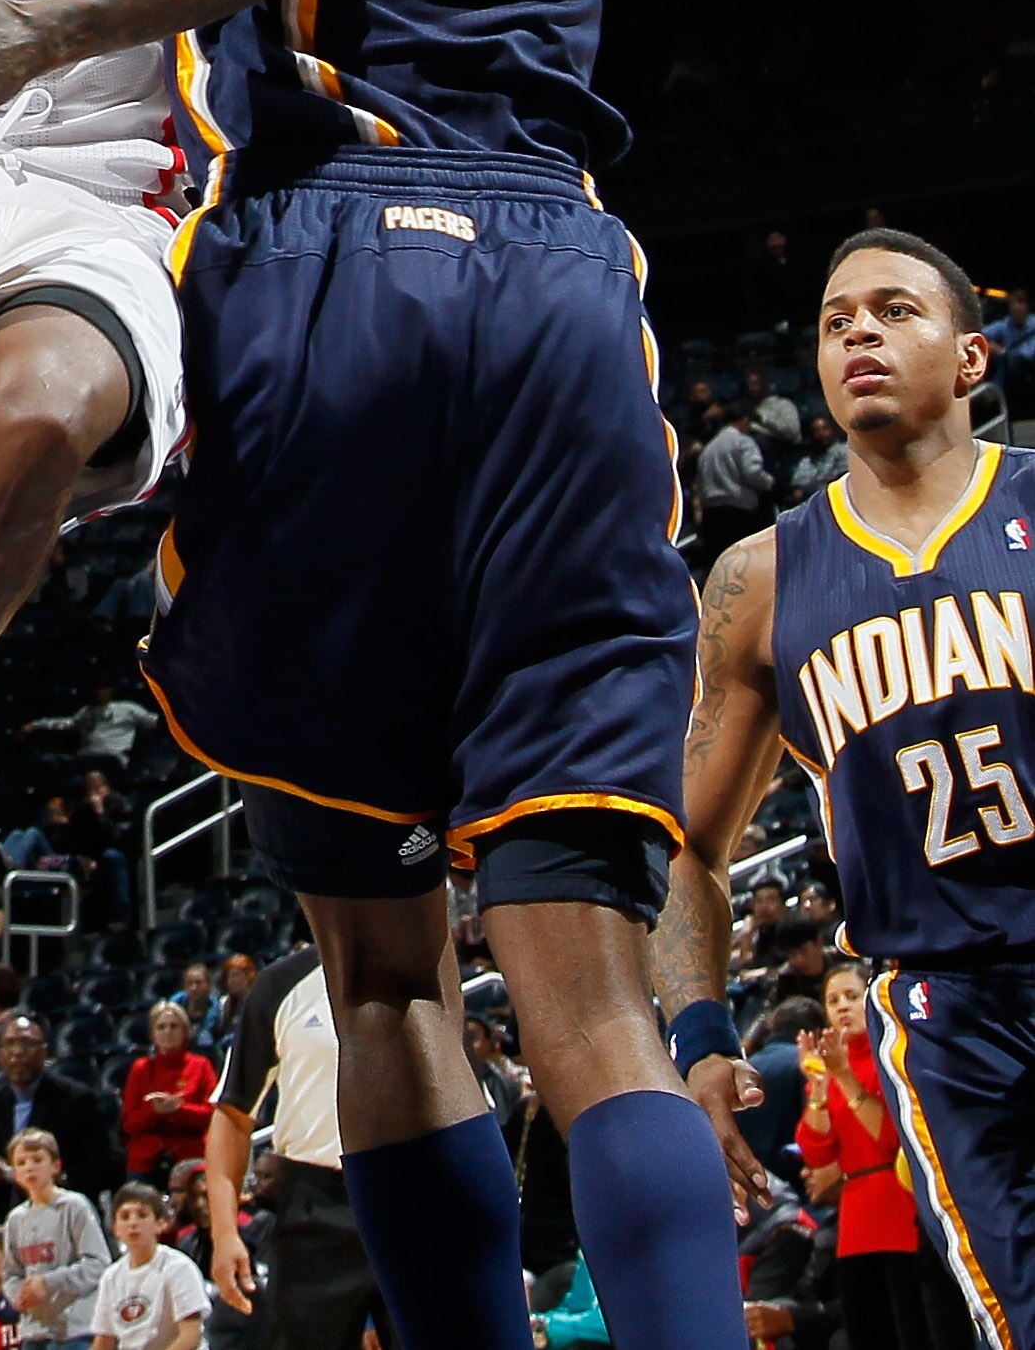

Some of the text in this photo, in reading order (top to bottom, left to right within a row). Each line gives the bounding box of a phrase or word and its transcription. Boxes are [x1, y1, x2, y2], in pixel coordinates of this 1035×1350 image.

[384, 205, 477, 244] PACERS
[799, 591, 1035, 772] INDIAN
[895, 724, 1035, 867] 25
[398, 832, 437, 856] adidas
